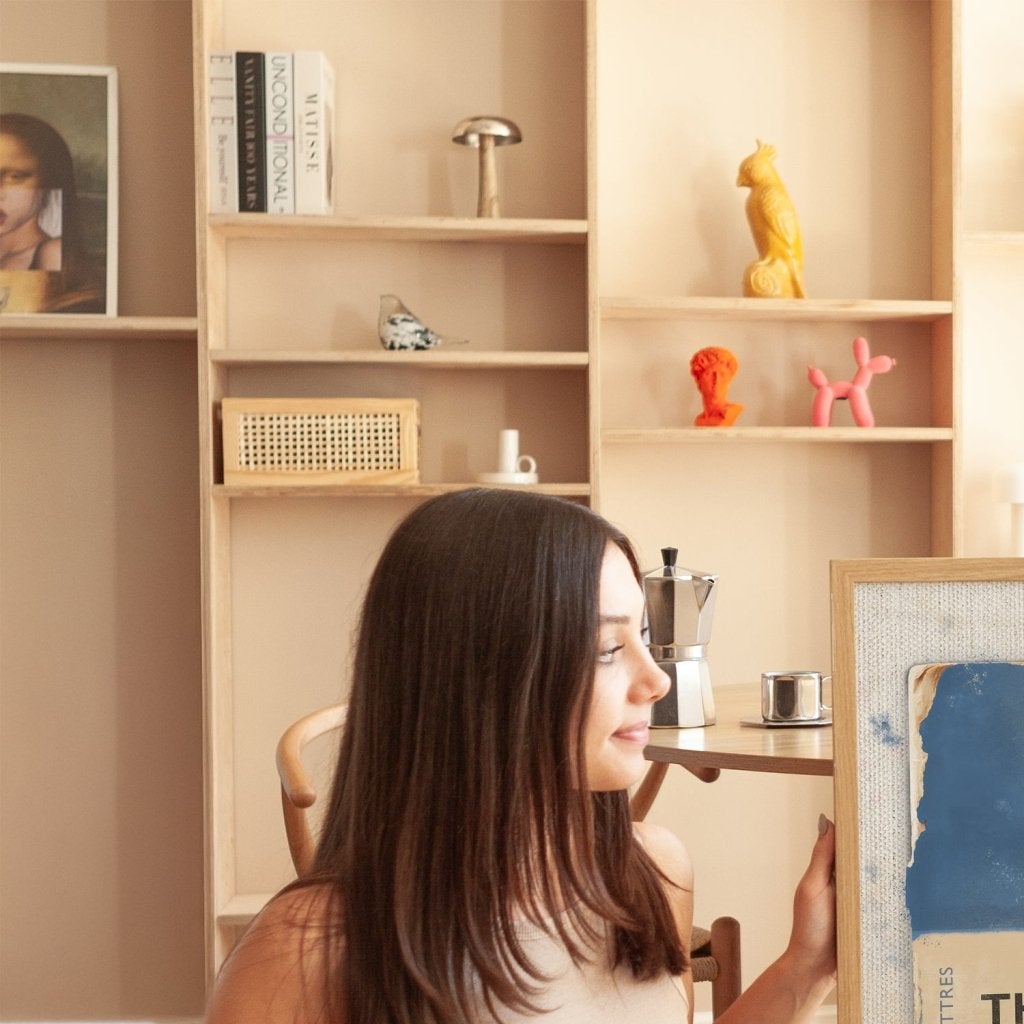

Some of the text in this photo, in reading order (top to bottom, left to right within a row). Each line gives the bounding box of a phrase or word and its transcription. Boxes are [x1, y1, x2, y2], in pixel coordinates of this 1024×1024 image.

[210, 55, 234, 127] ELLE
[244, 58, 255, 105] VANITY
[245, 109, 256, 139] FAIR
[271, 56, 289, 204] UNCONDITIONAL
[305, 93, 319, 173] MATISSE
[246, 167, 257, 209] YEARS
